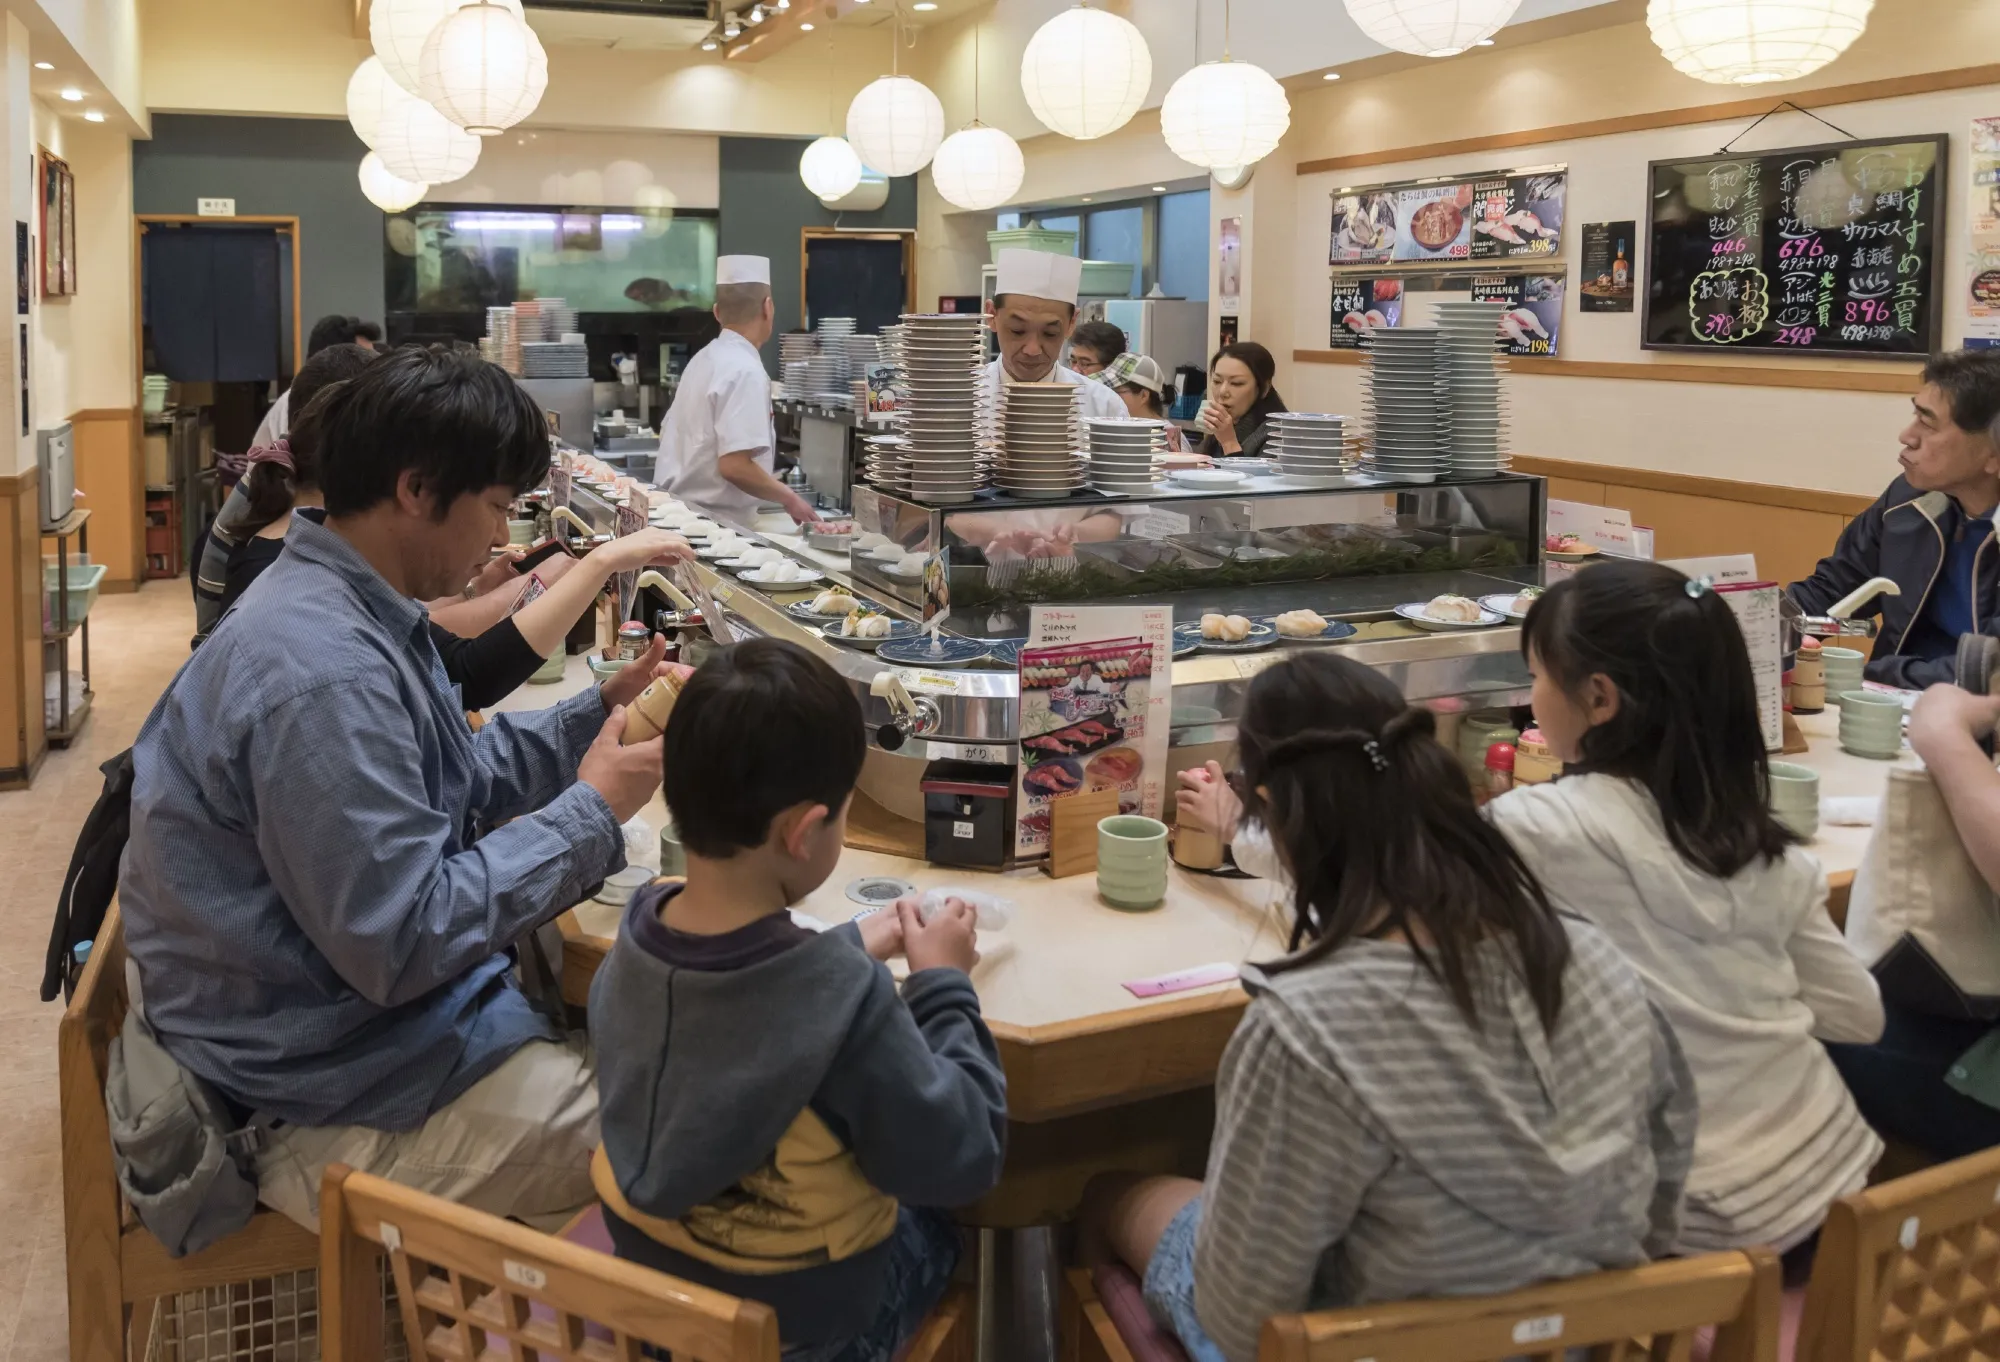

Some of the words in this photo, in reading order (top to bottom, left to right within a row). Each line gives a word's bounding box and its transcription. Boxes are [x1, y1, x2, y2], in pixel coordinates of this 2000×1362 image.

[1841, 220, 1903, 241] サクラマス
[1449, 245, 1469, 256] 498
[1529, 240, 1550, 253] 398
[1711, 237, 1746, 256] 446
[1779, 237, 1824, 258] 696
[1705, 253, 1755, 270] 198+248
[1779, 255, 1838, 271] 498+198
[1783, 276, 1811, 291] アジ
[1849, 272, 1890, 291] いくら
[1782, 288, 1817, 304] 小はだ
[1778, 306, 1811, 322] イワシ
[1845, 299, 1890, 322] 896
[1705, 313, 1734, 335] 398
[1773, 327, 1817, 345] 248
[1841, 325, 1895, 341] 498+398
[1530, 339, 1549, 353] 198
